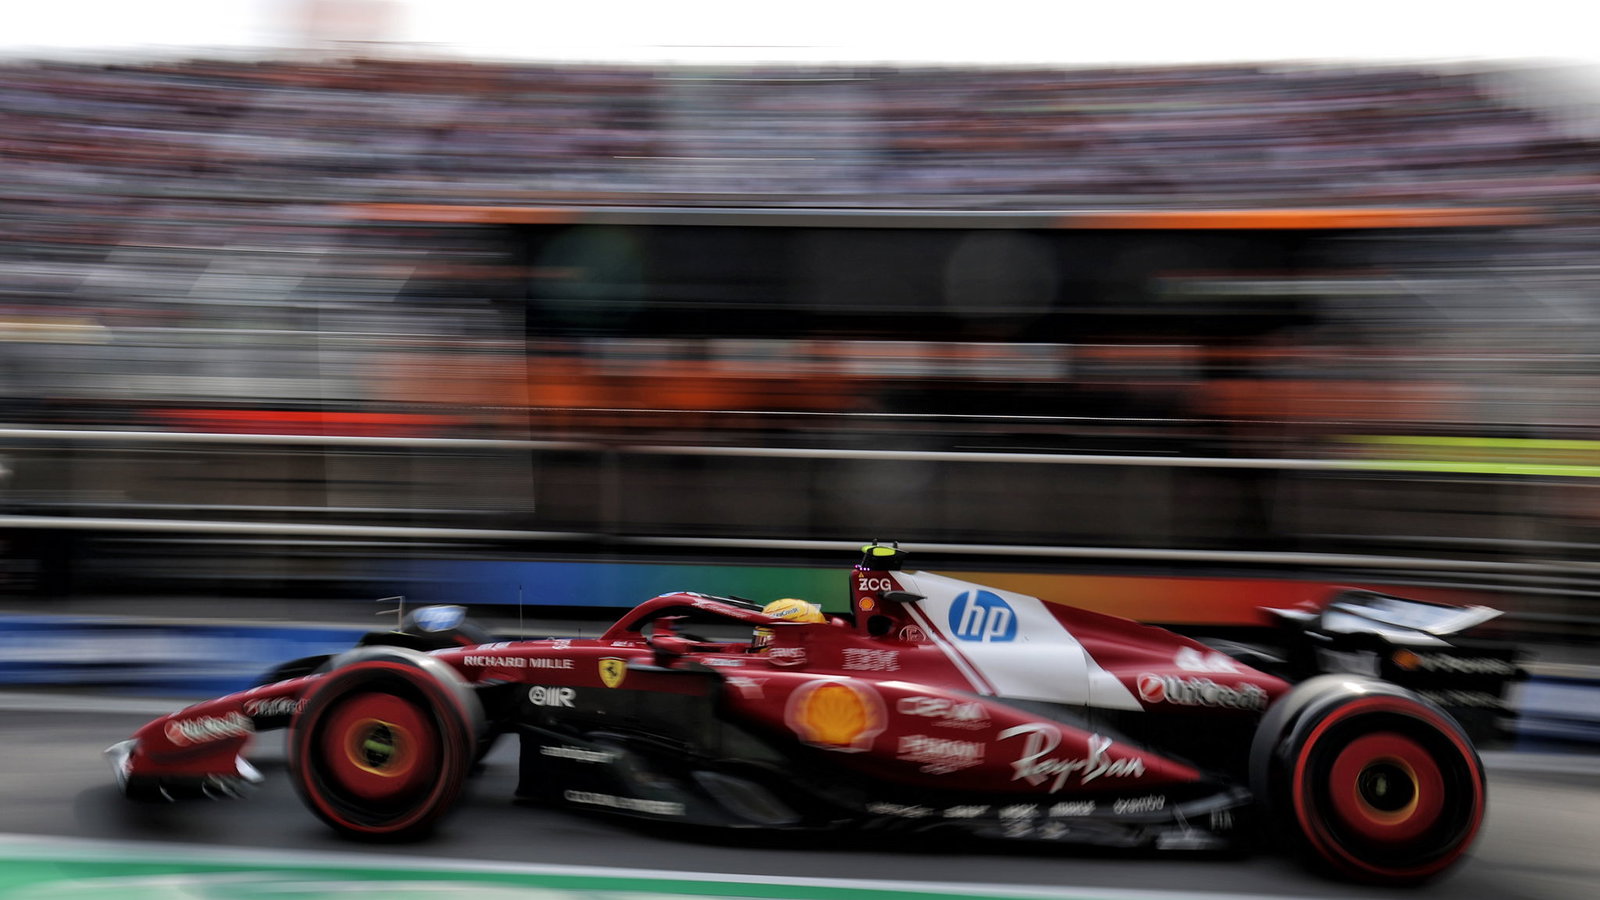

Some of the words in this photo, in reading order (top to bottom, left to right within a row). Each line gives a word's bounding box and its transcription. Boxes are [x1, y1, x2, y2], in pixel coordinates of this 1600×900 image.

[957, 590, 1010, 643] hp
[464, 656, 527, 668] RICHARD
[529, 658, 575, 669] MILLE
[996, 722, 1146, 794] Ray-Ban
